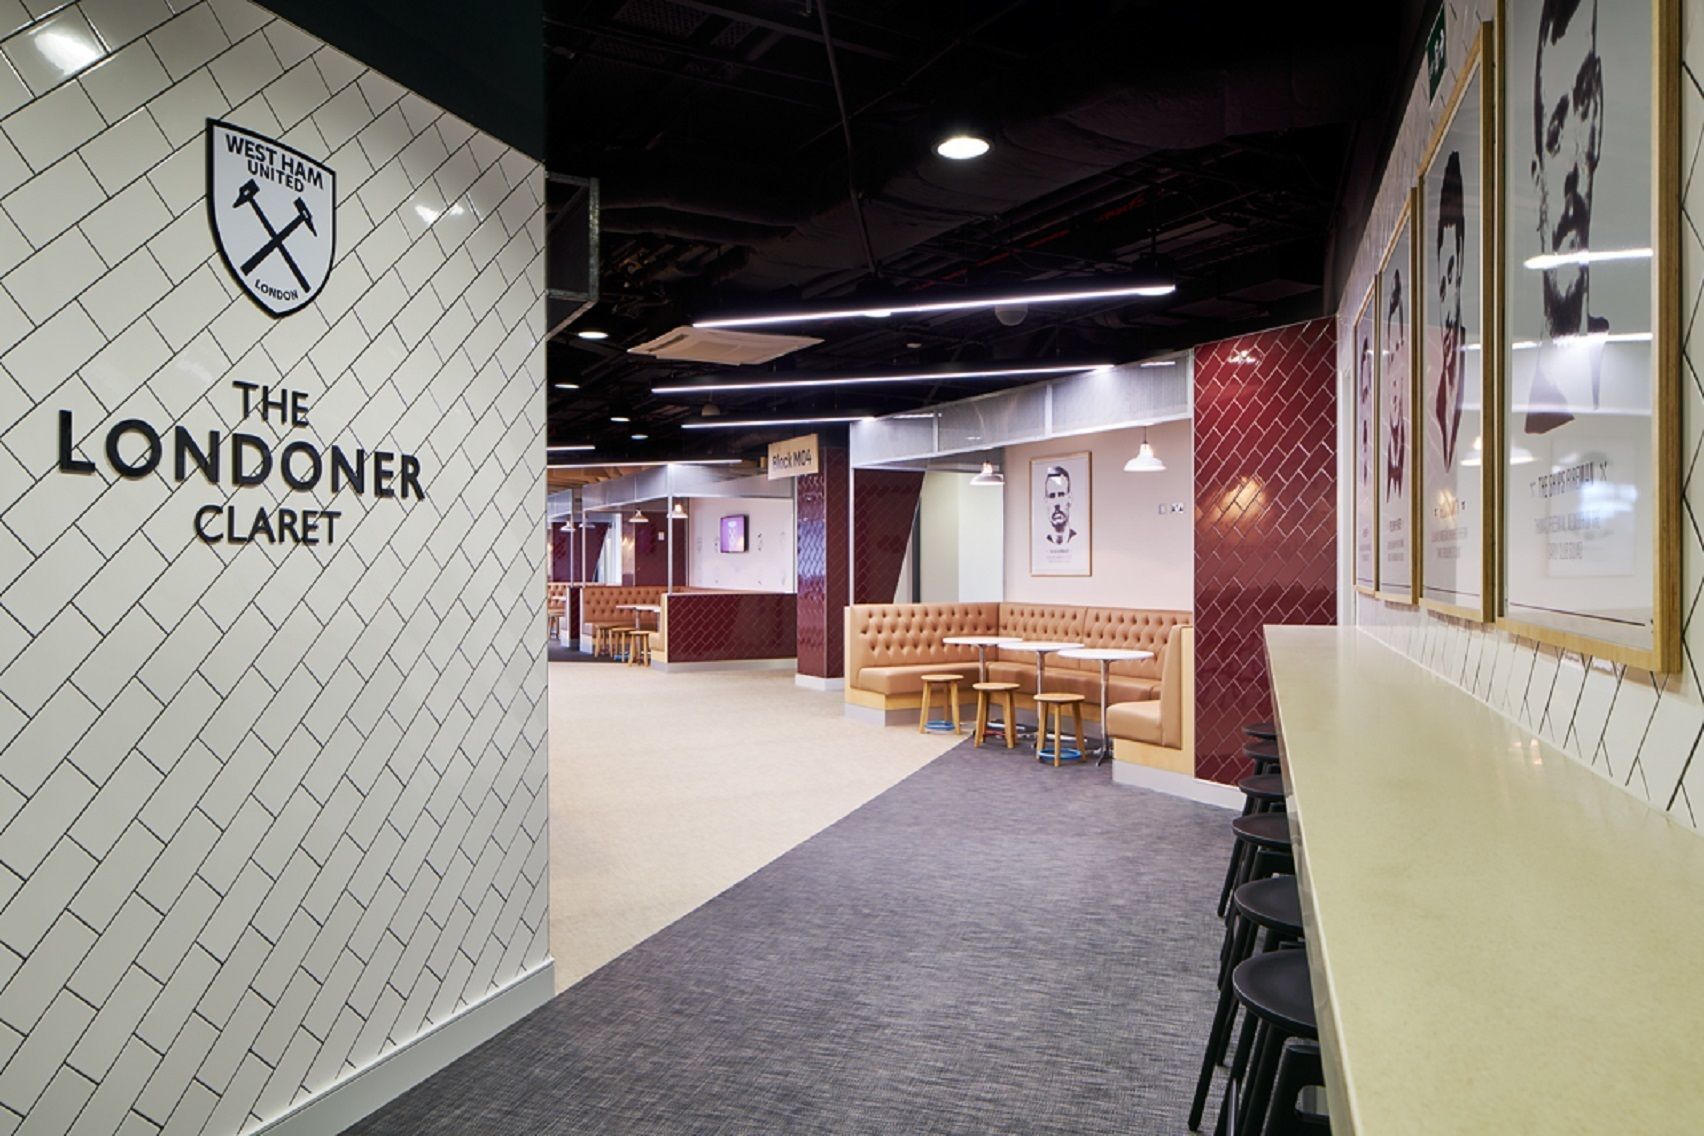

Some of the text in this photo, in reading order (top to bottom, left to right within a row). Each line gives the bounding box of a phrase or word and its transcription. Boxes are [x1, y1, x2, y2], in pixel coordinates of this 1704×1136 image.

[225, 133, 324, 190] WEST HAM
[247, 159, 305, 193] UNITED
[254, 278, 299, 301] LONDON
[232, 380, 309, 428] THE
[58, 409, 425, 501] LONDONER
[193, 504, 342, 546] CLARET
